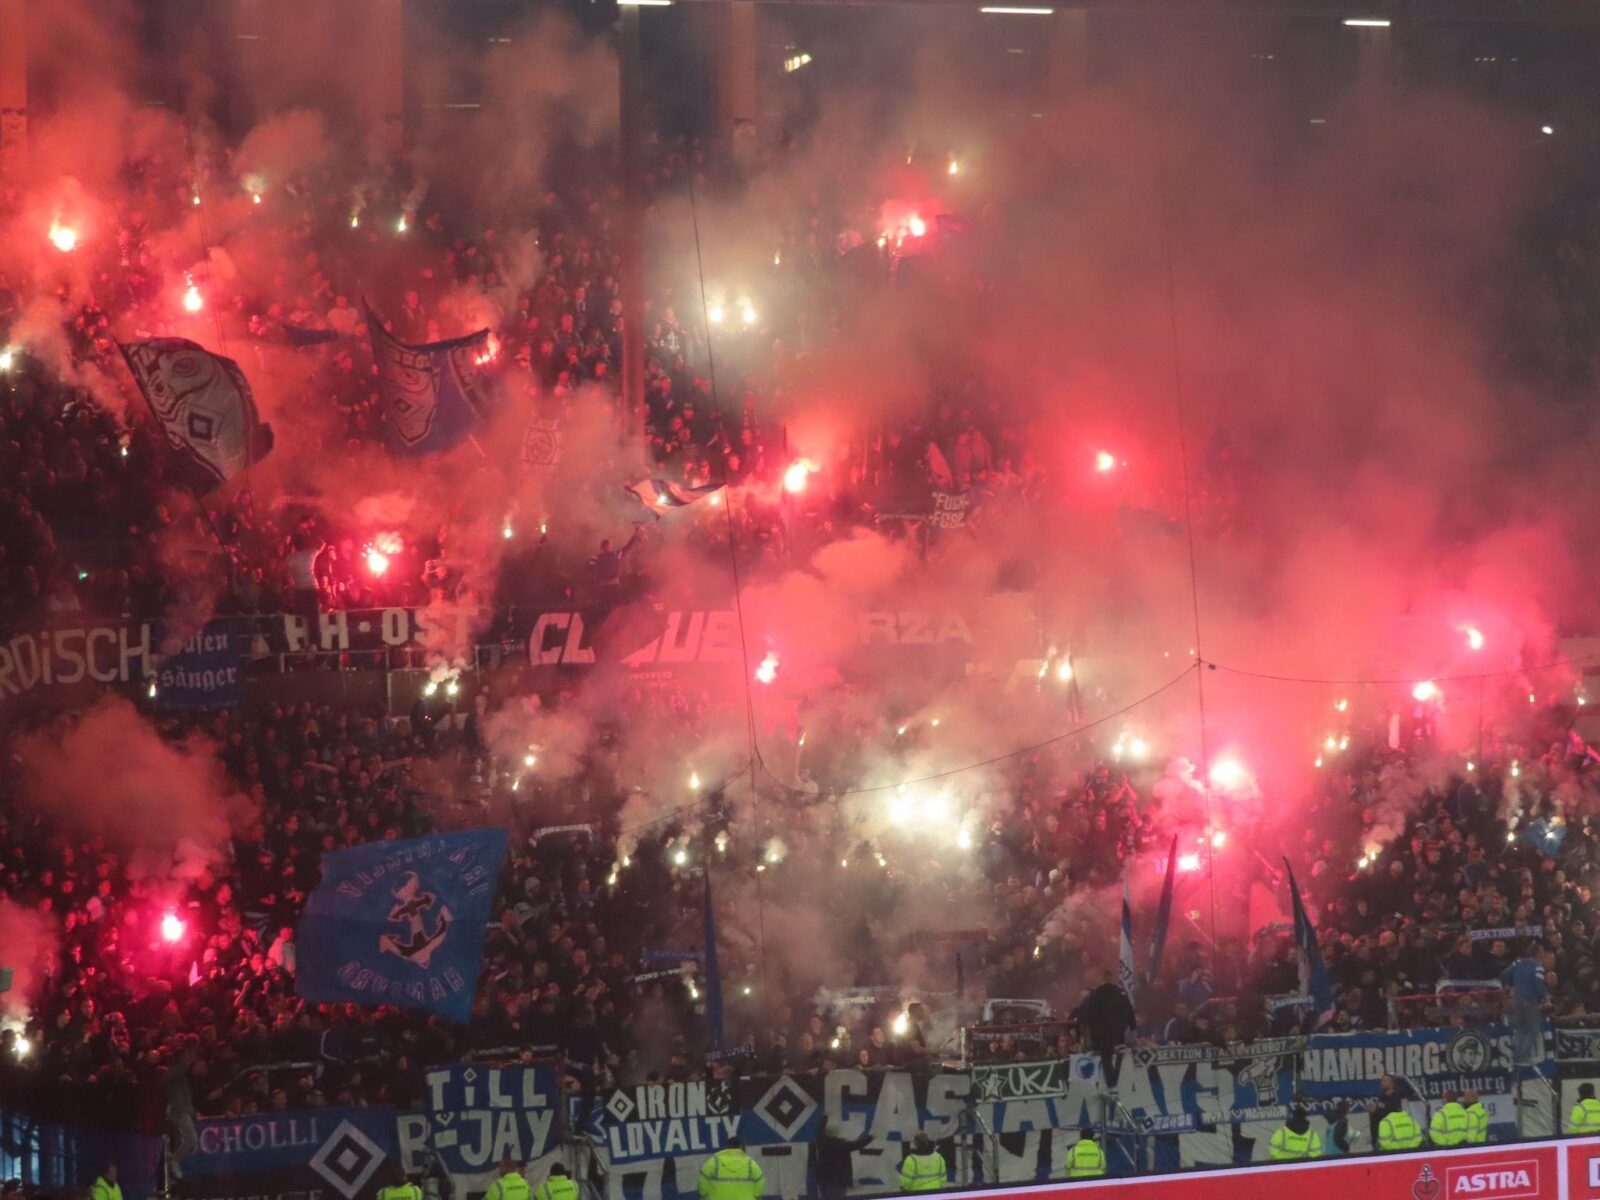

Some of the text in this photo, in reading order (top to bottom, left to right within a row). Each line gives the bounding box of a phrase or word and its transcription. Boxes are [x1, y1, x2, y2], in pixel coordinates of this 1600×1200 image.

[530, 612, 742, 664] CLUE
[161, 665, 238, 692] sänger
[1302, 1041, 1440, 1083] HAMBURG
[635, 1081, 706, 1120] IRON
[190, 1117, 319, 1154] CHOLLI
[610, 1115, 742, 1159] LOYALTY
[1454, 1169, 1531, 1193] ASTRA
